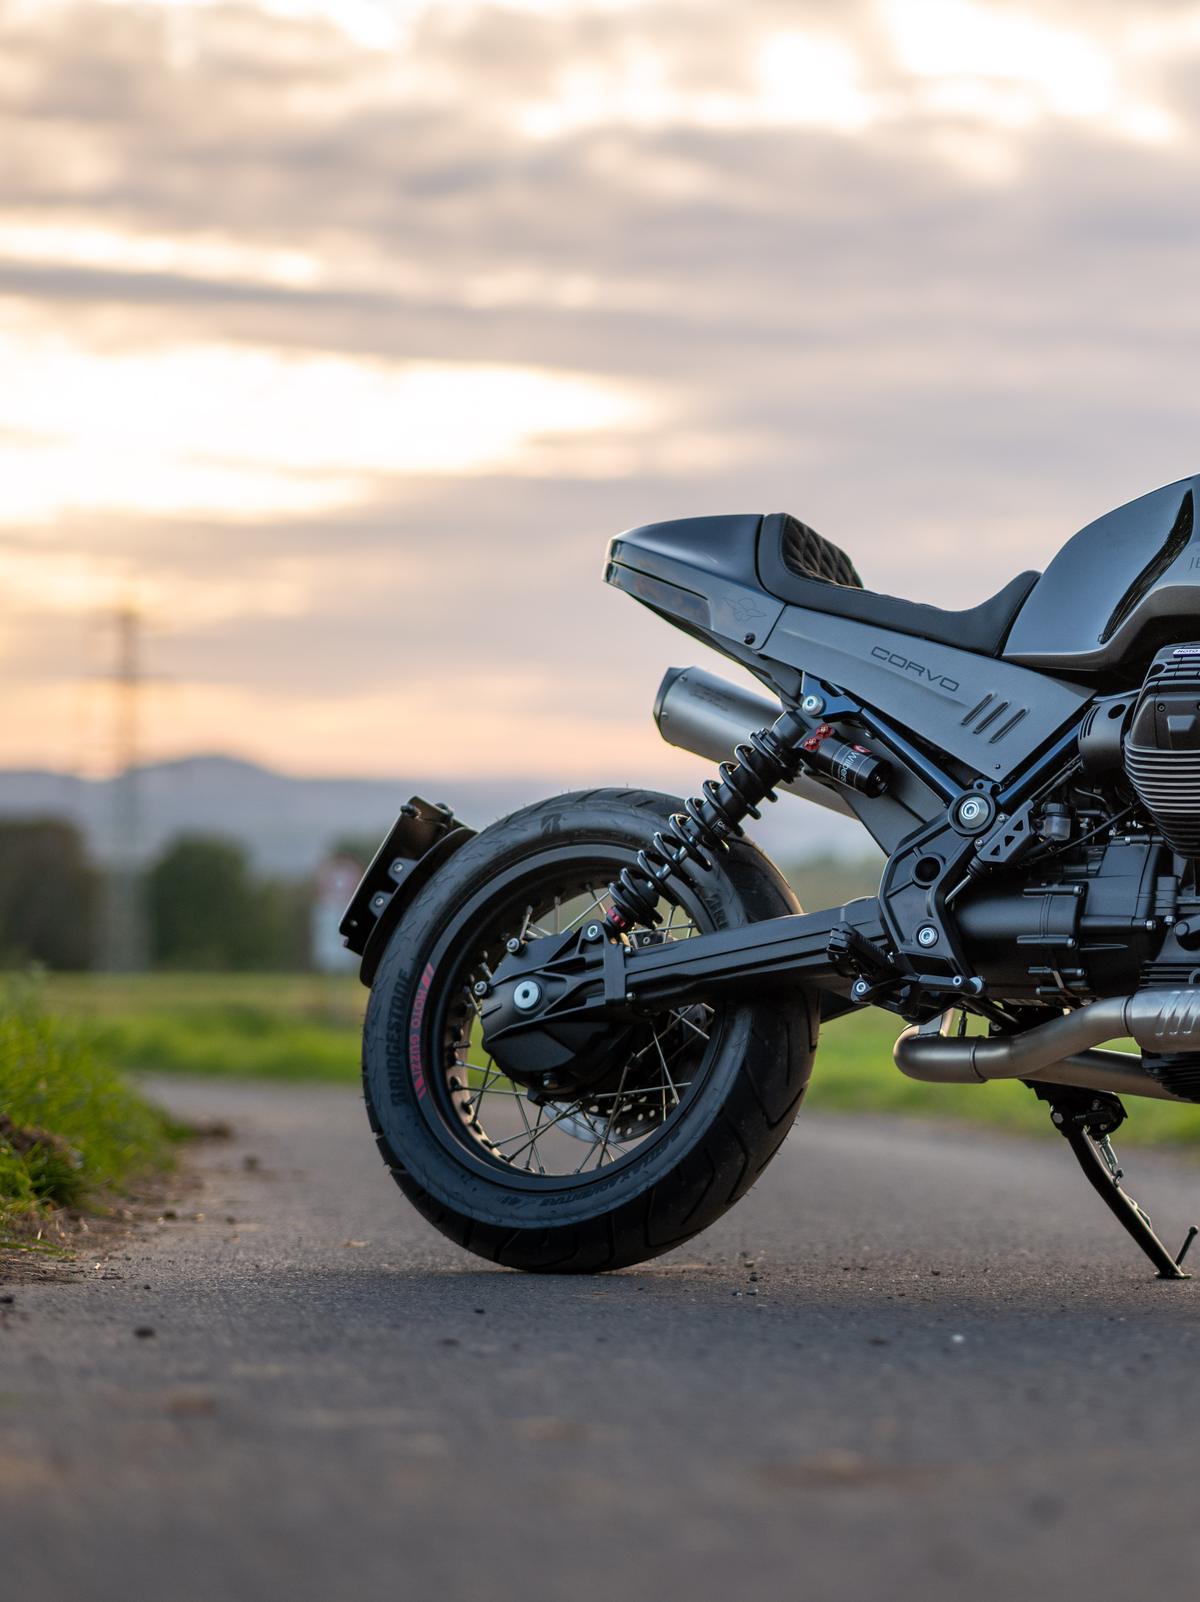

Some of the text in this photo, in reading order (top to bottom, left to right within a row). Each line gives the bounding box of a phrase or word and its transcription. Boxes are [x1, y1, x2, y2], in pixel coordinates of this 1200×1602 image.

[871, 646, 960, 692] CORVO
[385, 968, 409, 1106] BRIDGESTONE
[409, 988, 427, 1077] MOTO GUZZI
